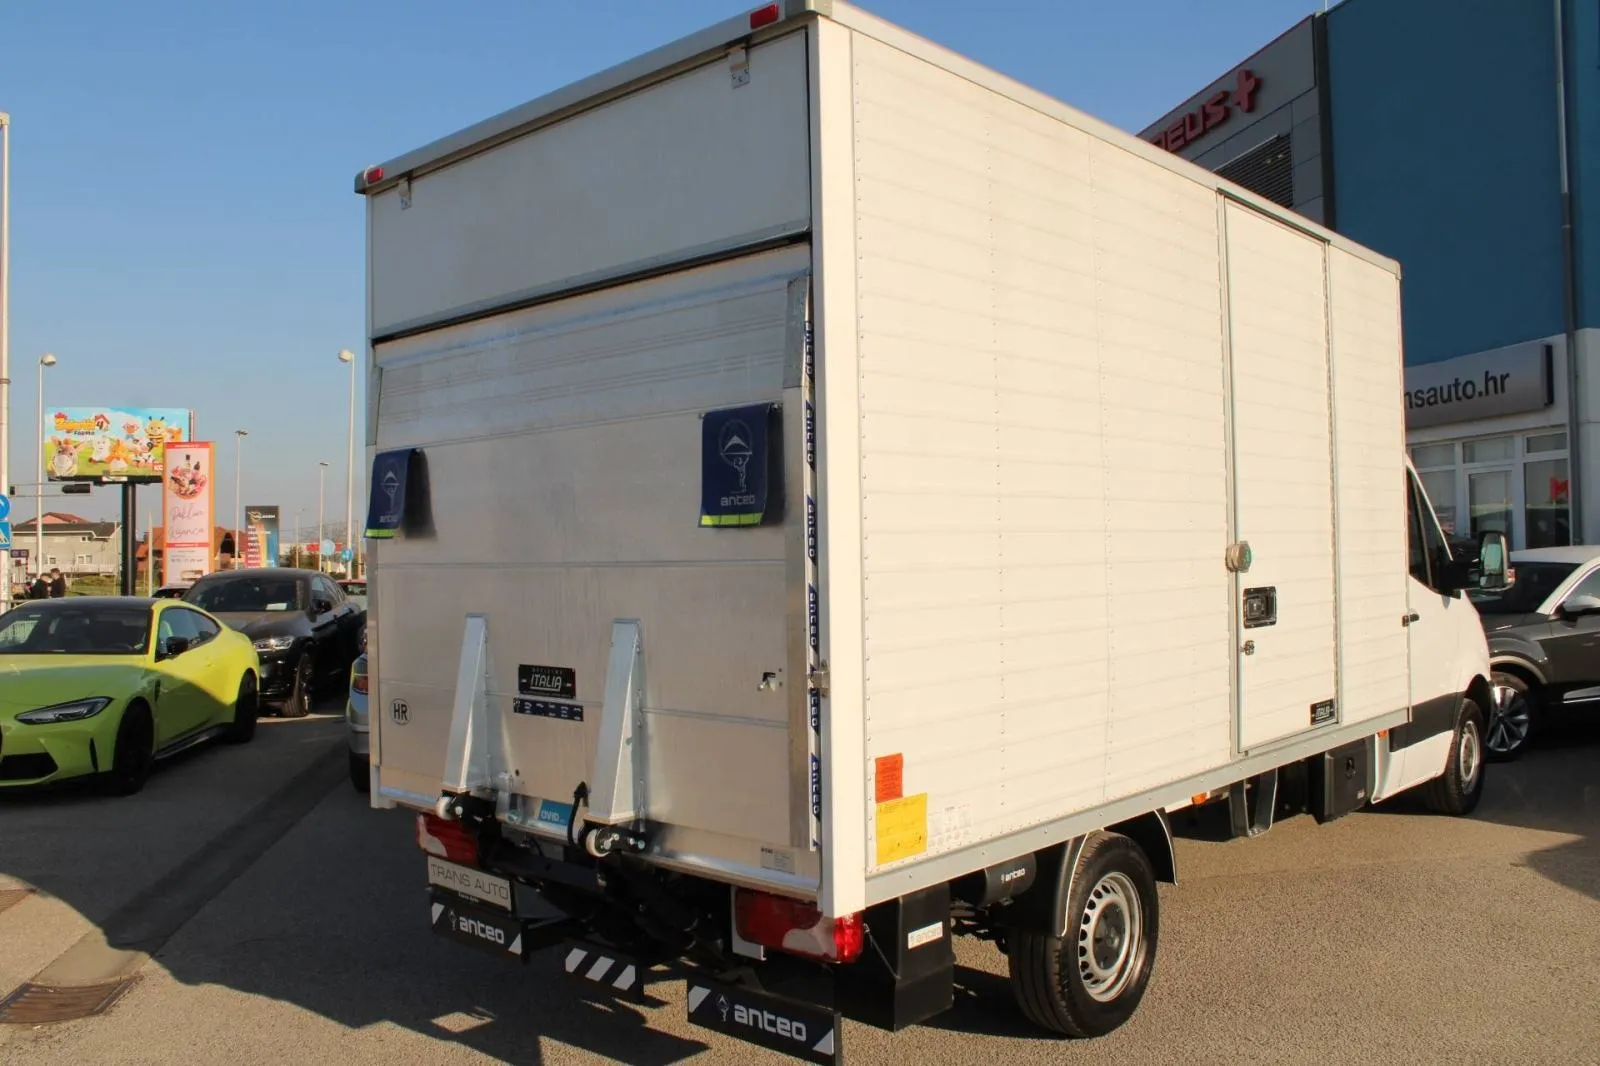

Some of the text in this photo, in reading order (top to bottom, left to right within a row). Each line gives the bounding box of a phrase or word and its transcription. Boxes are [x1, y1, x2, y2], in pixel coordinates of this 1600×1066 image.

[720, 494, 756, 507] anteo
[530, 674, 562, 689] ITALIA
[393, 702, 408, 721] HR
[431, 864, 509, 899] TRANS AUTO
[459, 916, 505, 945] anteo
[734, 1003, 807, 1042] anteo
